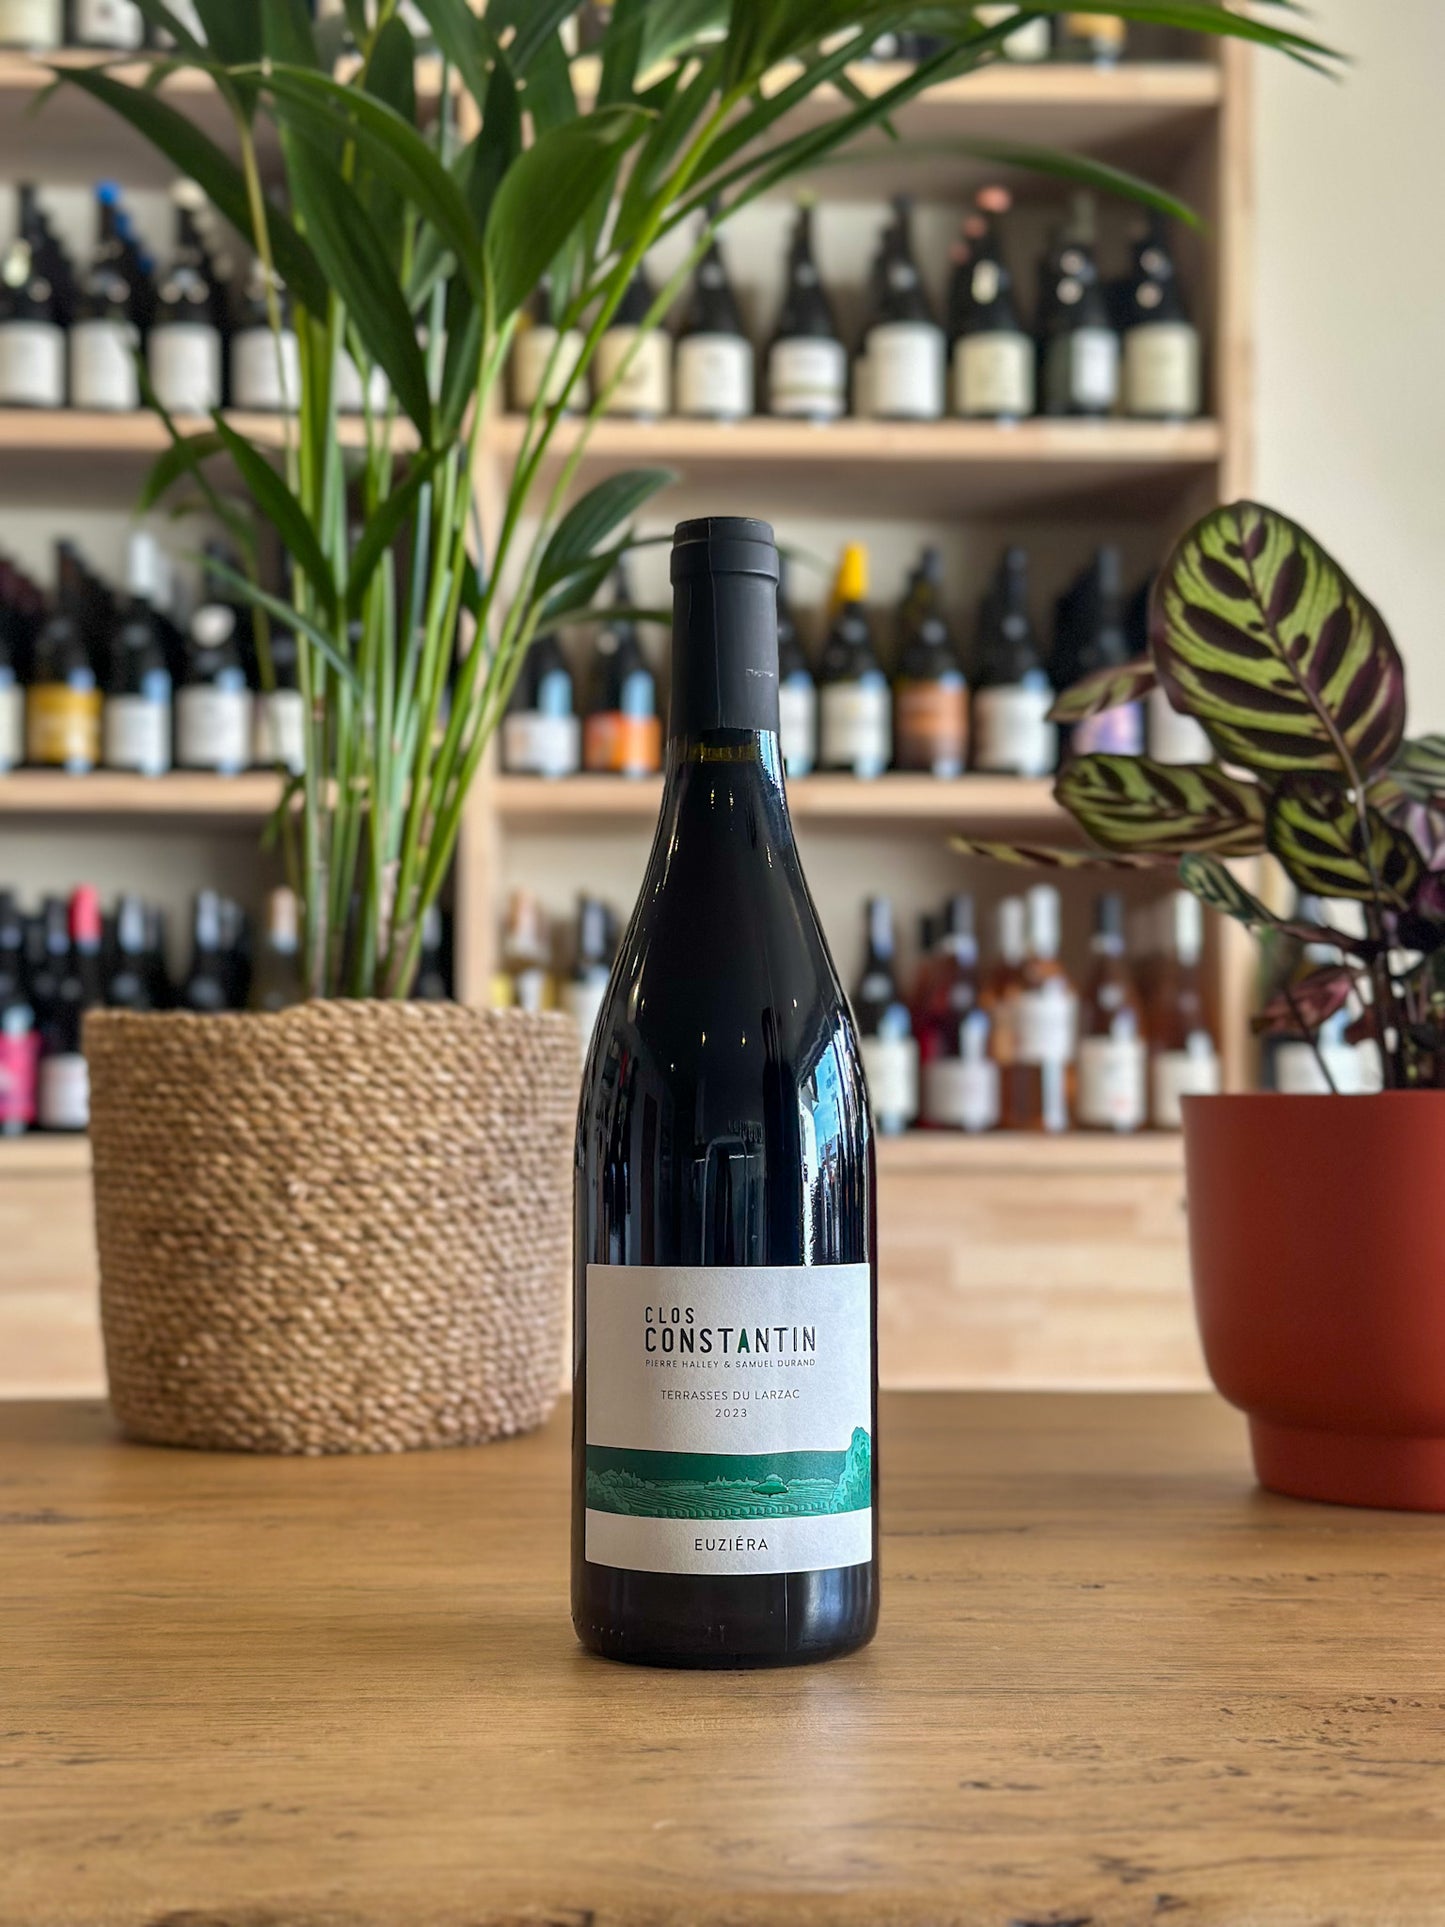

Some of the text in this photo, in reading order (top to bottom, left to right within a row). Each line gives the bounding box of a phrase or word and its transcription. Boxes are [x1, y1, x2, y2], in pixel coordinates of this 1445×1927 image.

[645, 1306, 695, 1324] CLOS
[645, 1326, 816, 1353] CONSTANTIN
[645, 1358, 816, 1369] PIERRE HALLEY & SAMUEL DURAND
[661, 1389, 800, 1401] TERRASSES DU LARZAC
[715, 1408, 748, 1418] 2023
[694, 1535, 769, 1551] EUZIÉRA
